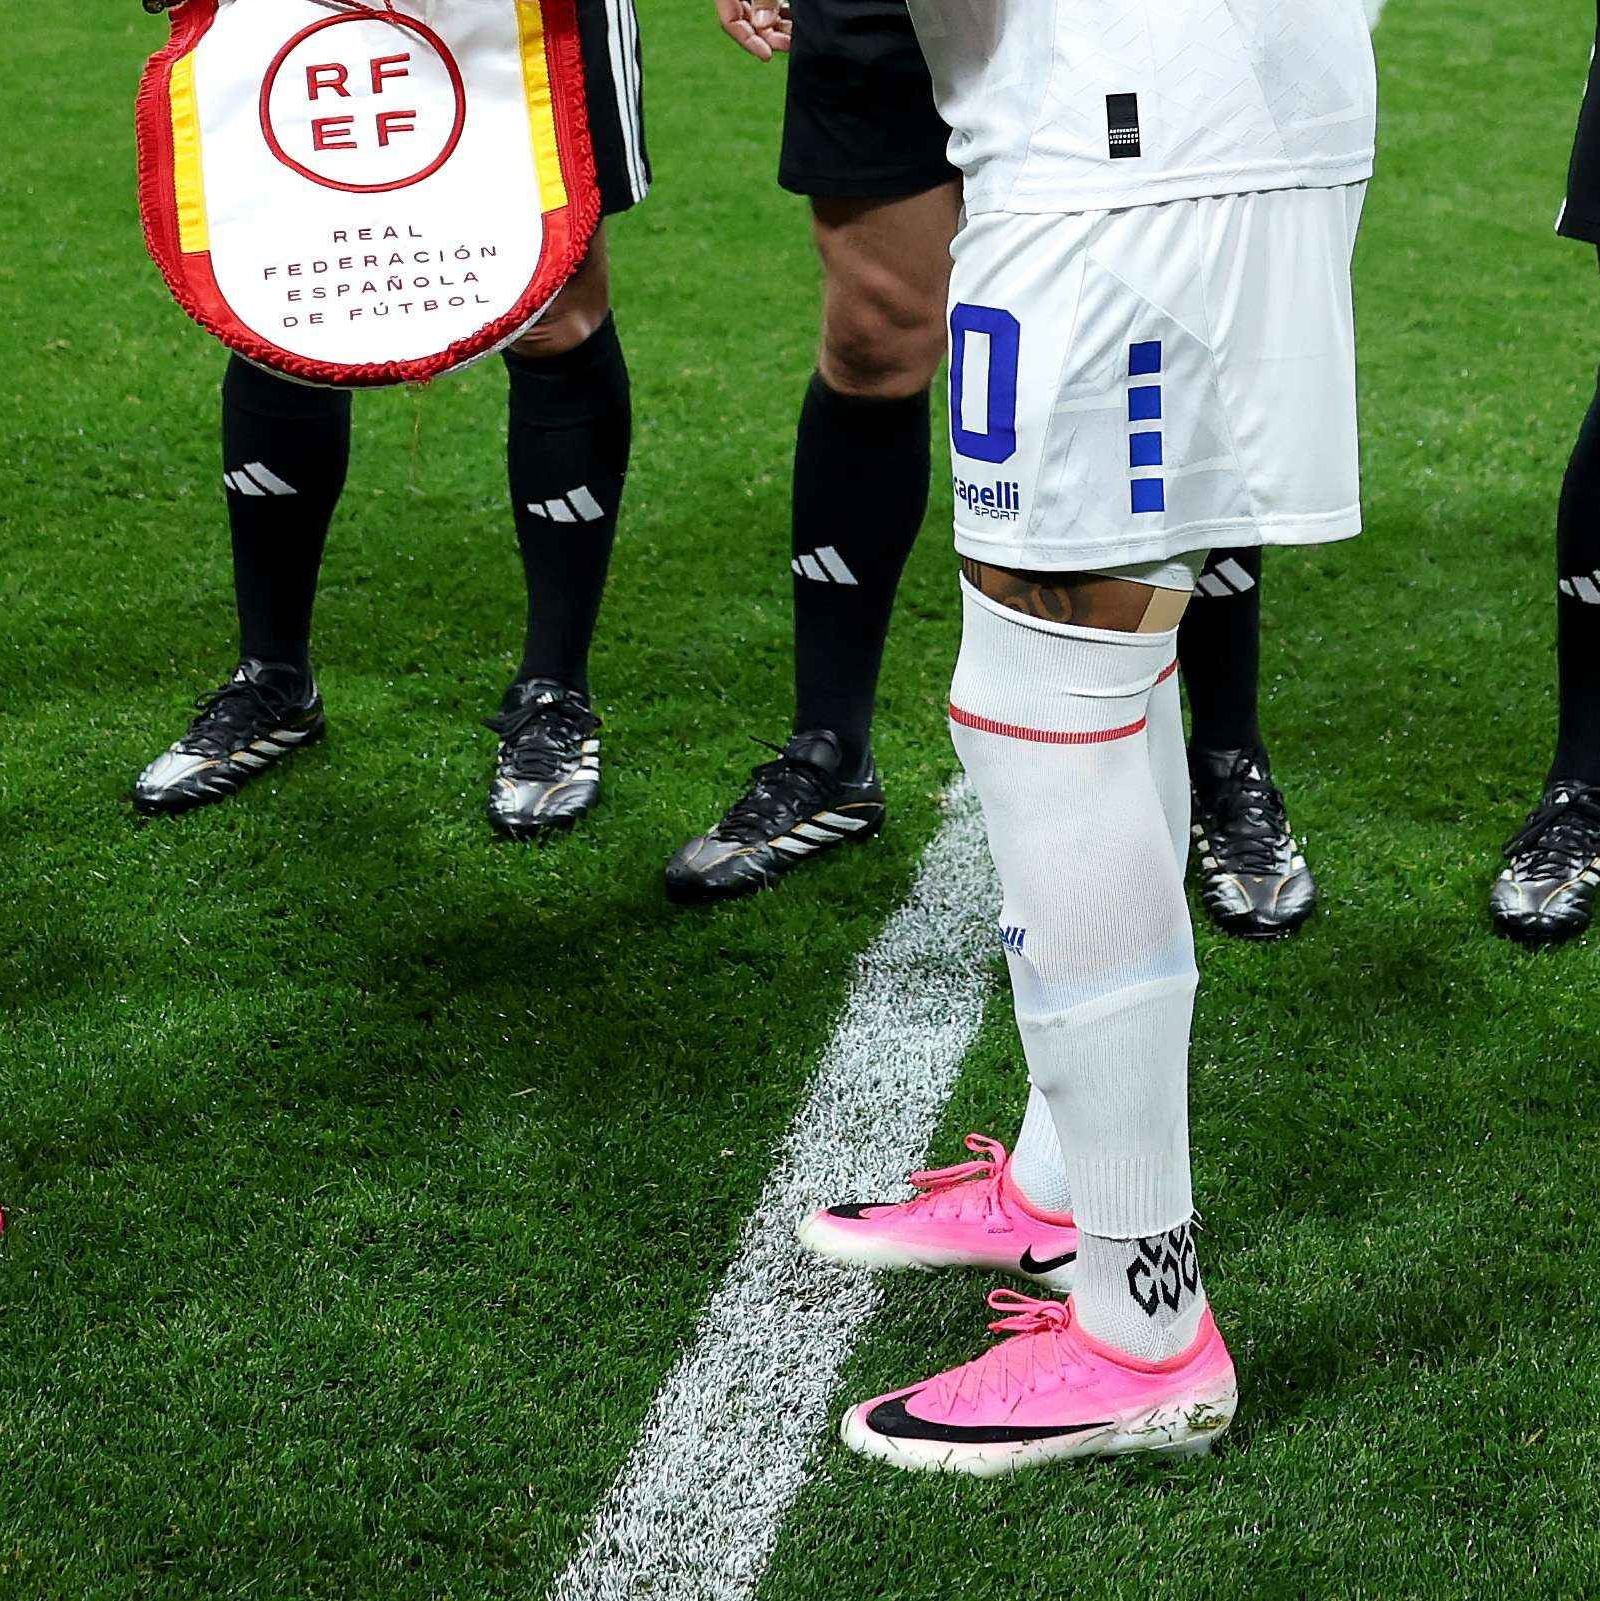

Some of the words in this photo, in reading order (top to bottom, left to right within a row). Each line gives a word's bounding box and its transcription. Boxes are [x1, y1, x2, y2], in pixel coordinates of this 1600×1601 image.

[334, 225, 423, 242] REAL
[264, 245, 496, 280] FEDERACIÓN
[287, 272, 479, 301] ESPAÑOLA
[283, 312, 324, 328] DE
[349, 294, 490, 321] FÚTBOL
[975, 505, 1019, 521] SPORT
